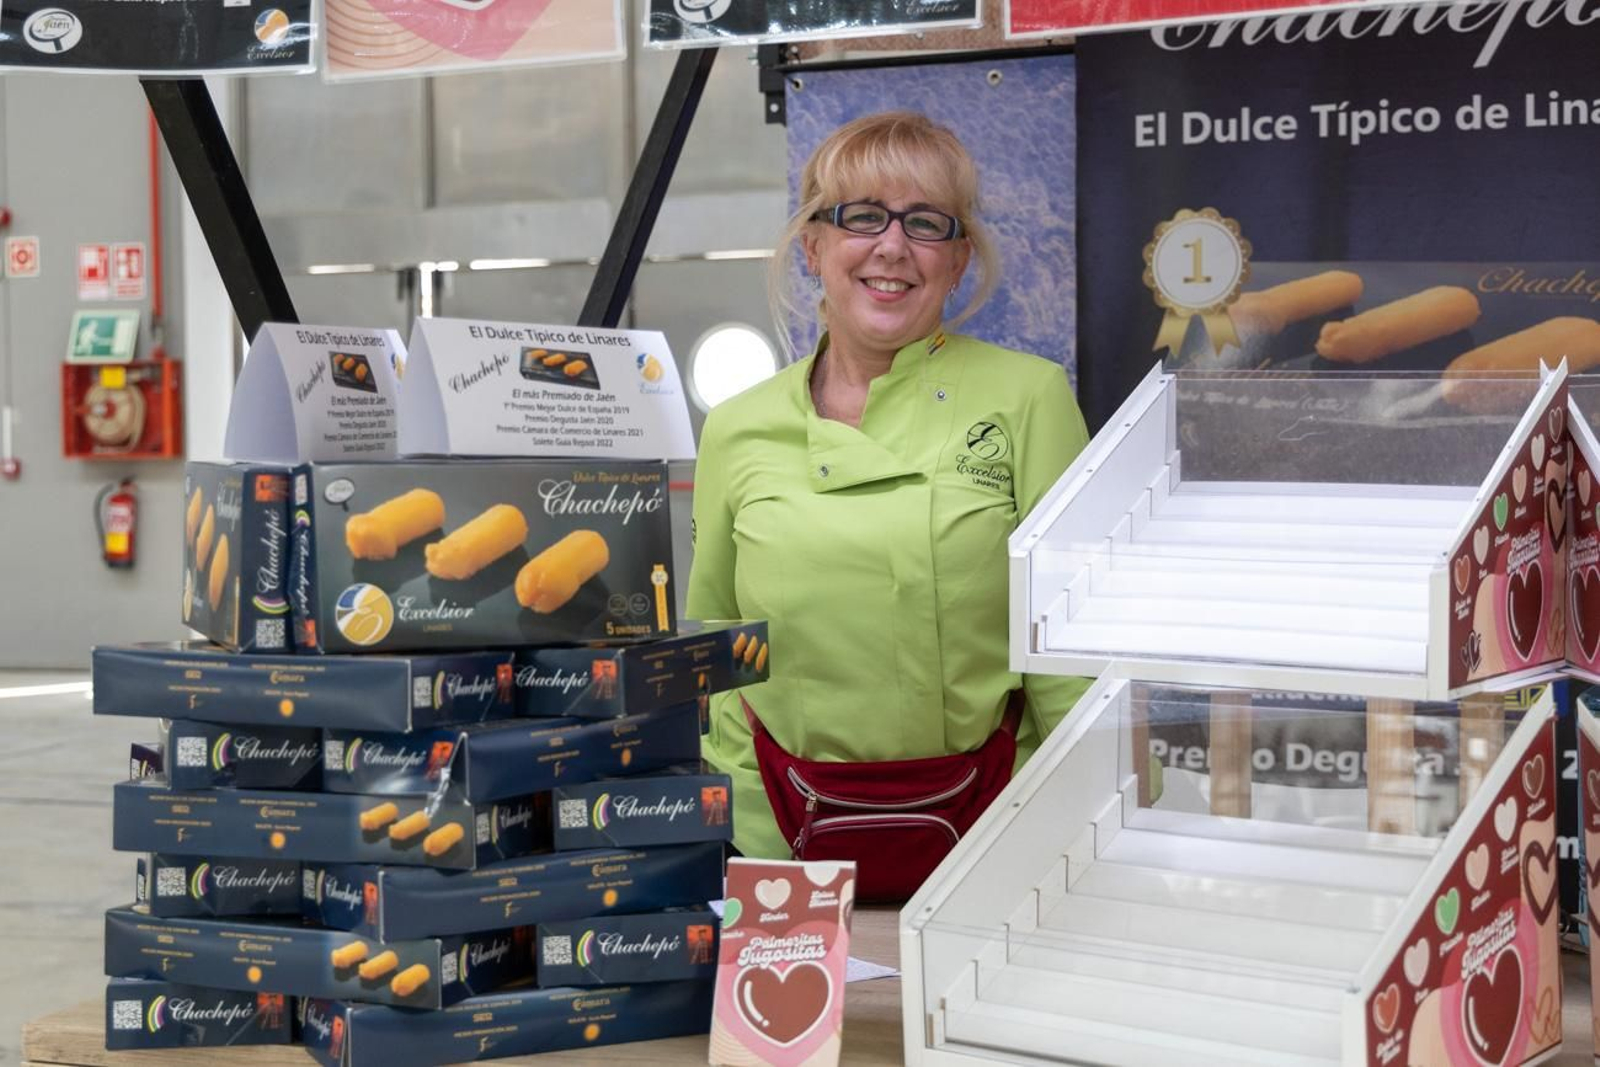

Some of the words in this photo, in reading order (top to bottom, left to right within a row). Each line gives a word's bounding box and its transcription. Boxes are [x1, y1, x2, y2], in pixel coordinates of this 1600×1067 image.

[1134, 112, 1167, 148] El
[1182, 107, 1297, 145] Dulce
[1310, 99, 1440, 146] Típico
[1455, 95, 1509, 131] de
[1182, 237, 1213, 284] 1
[469, 325, 483, 339] El
[485, 326, 524, 341] Dulce
[568, 332, 585, 344] de
[586, 333, 631, 347] Linares
[512, 388, 521, 399] El
[523, 388, 540, 400] más
[542, 390, 582, 401] Premiado
[584, 391, 596, 402] de
[597, 392, 616, 403] Jaén
[956, 454, 1011, 483] Excelsior
[538, 479, 663, 526] Chachepó
[256, 508, 287, 593] Chachepó
[397, 595, 474, 622] Excelsior
[606, 621, 615, 636] 5
[515, 665, 590, 694] Chachepó
[234, 736, 317, 765] Chachepó
[362, 740, 426, 773] Chachepó
[1149, 739, 1275, 772] Preo
[612, 796, 696, 822] Chachepó
[213, 866, 296, 893] Chachepó
[598, 934, 681, 959] Chachepó
[750, 933, 823, 951] Palmeritas
[737, 945, 827, 970] Jugositas
[169, 998, 254, 1025] Chachepó
